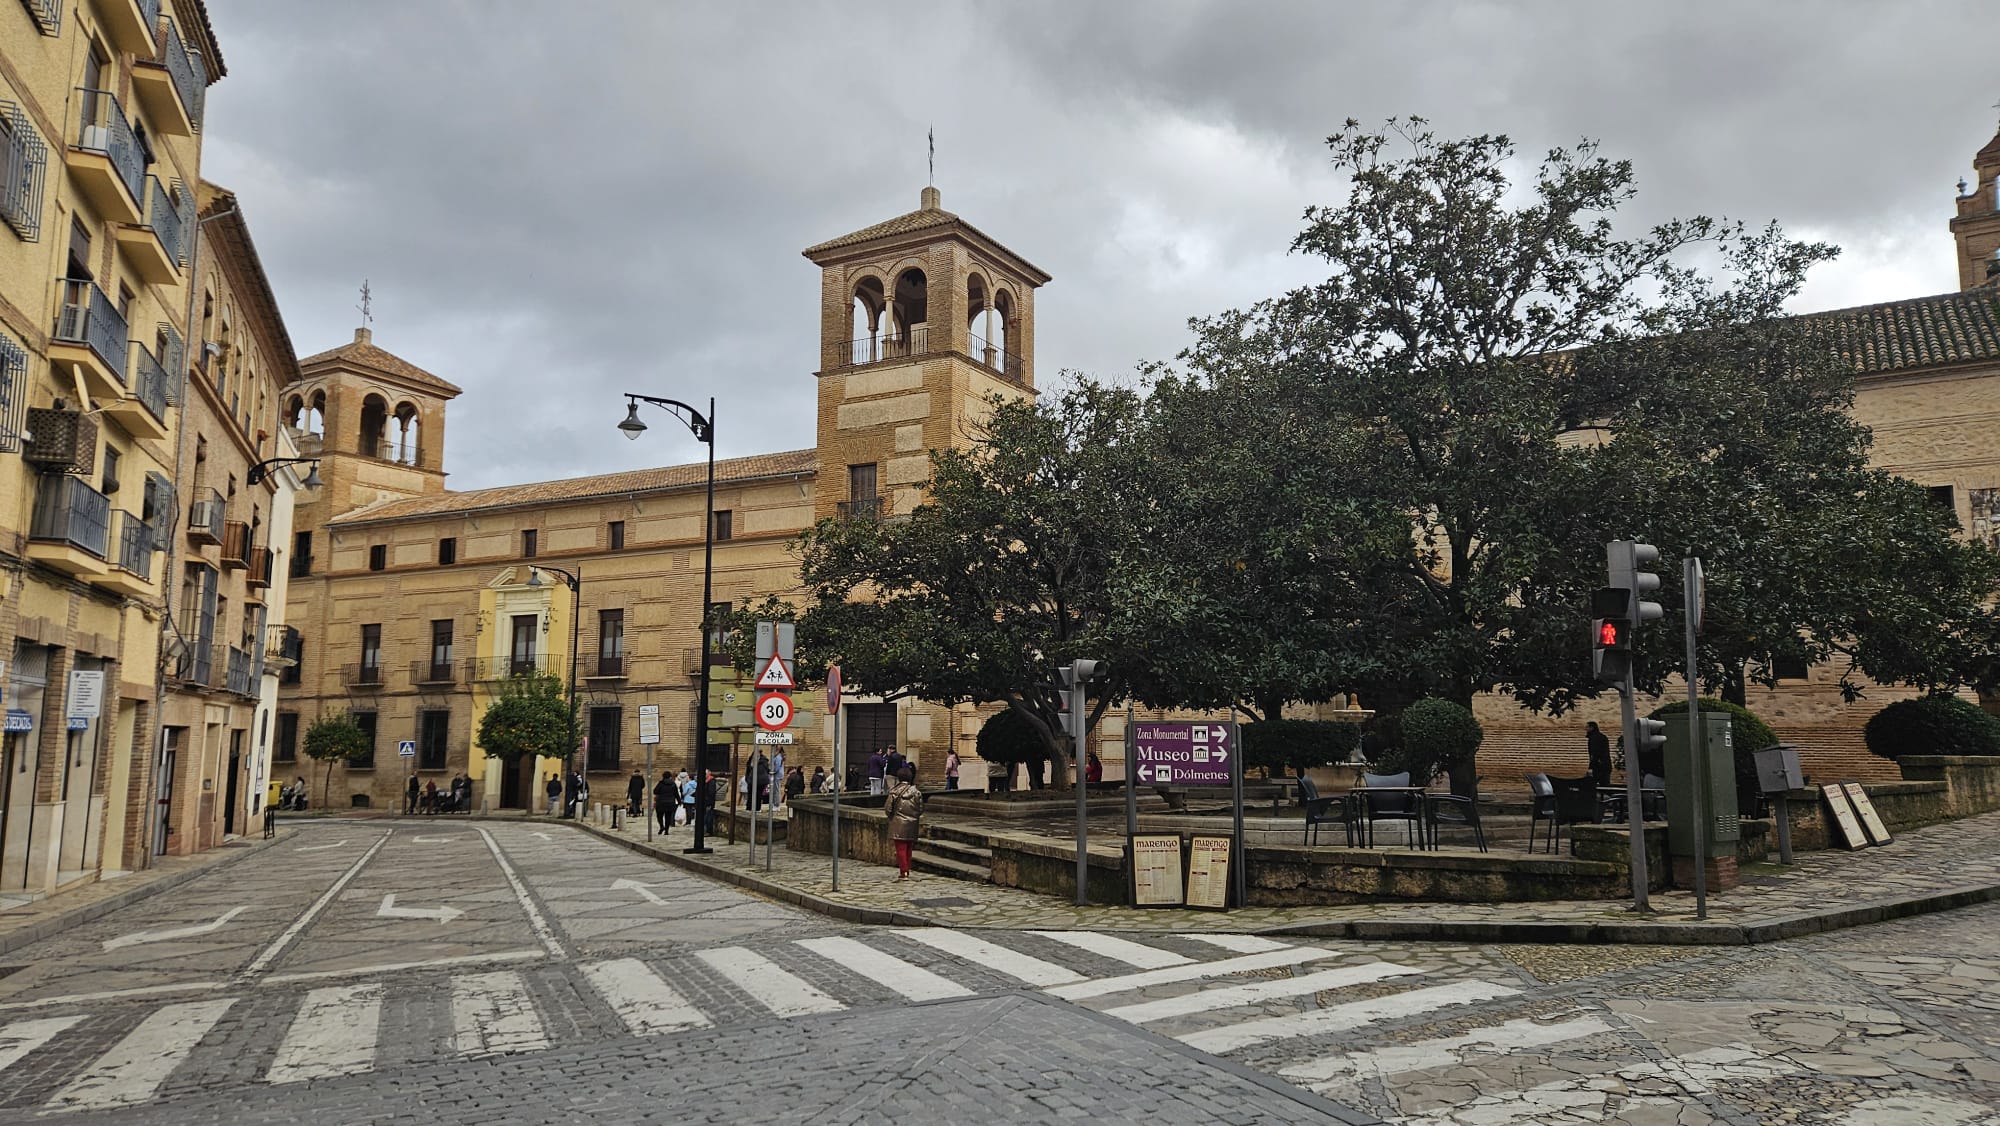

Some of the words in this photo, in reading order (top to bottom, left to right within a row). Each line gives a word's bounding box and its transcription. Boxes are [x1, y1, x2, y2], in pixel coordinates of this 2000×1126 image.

[766, 705, 784, 718] 30
[1137, 728, 1152, 740] Zona
[1153, 727, 1189, 740] Monumental
[1137, 745, 1190, 762] Museo
[1174, 768, 1229, 780] Dólmenes
[1136, 839, 1178, 848] MARENGO
[1194, 839, 1228, 848] MARENGO
